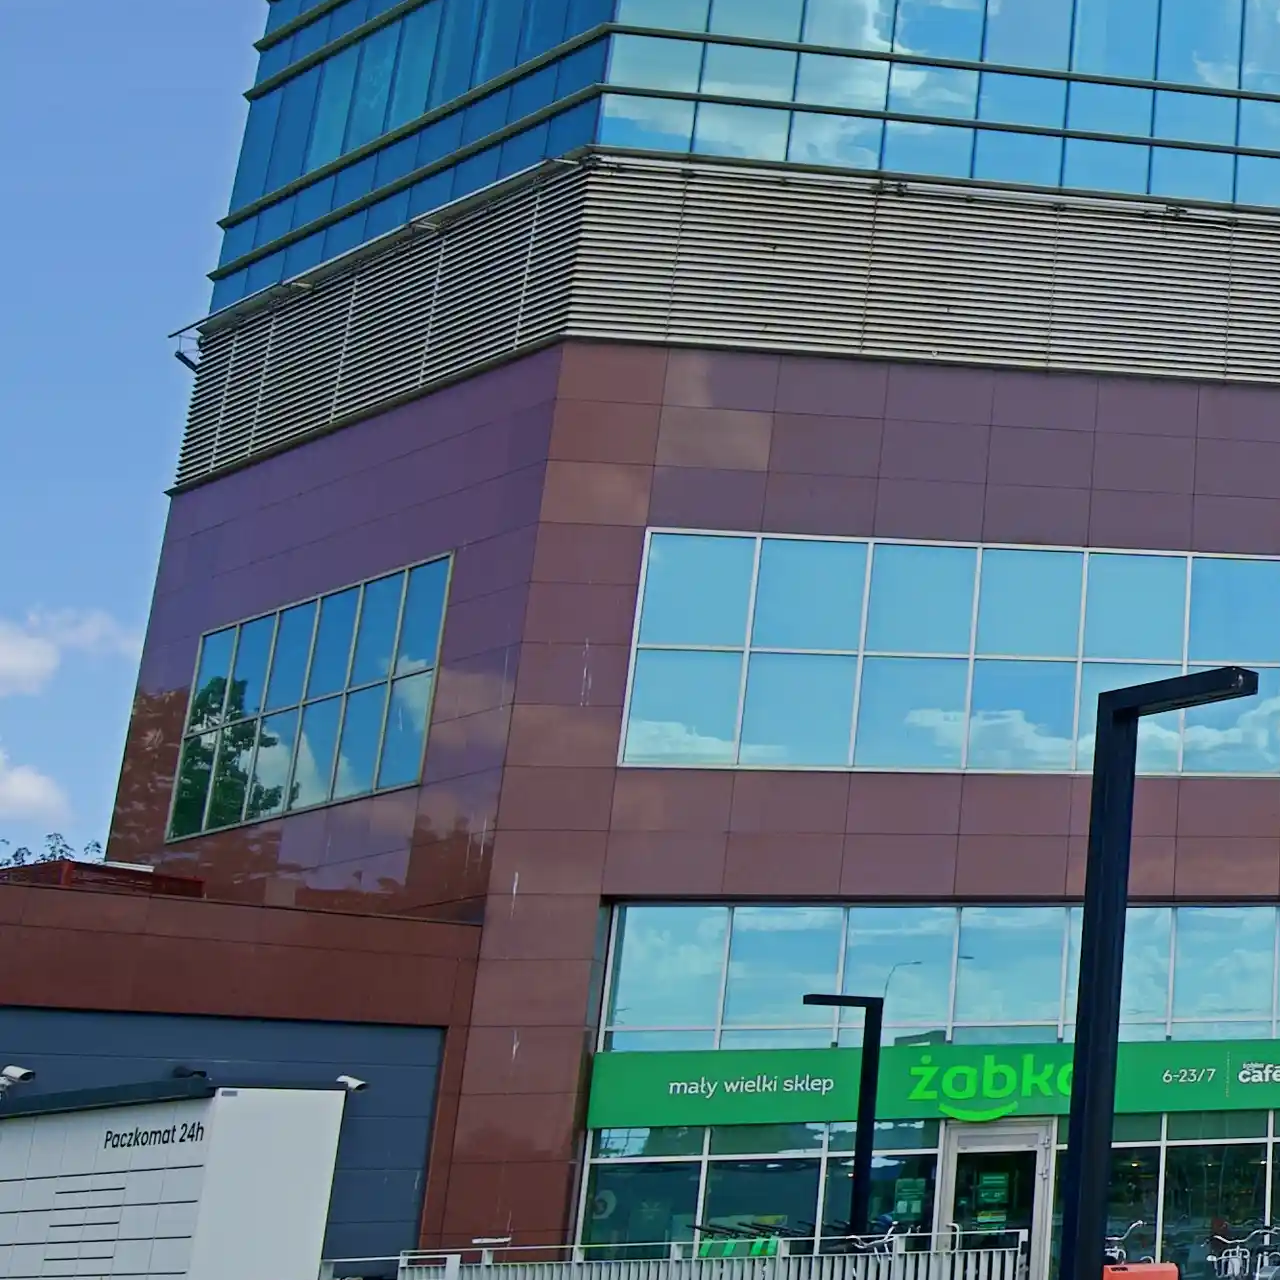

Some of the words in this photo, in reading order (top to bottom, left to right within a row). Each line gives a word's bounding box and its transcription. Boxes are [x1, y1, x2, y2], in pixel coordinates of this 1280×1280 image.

[668, 1075, 718, 1099] mały
[723, 1075, 778, 1093] wielki
[783, 1074, 834, 1096] sklep
[1162, 1068, 1217, 1083] 6-23/7
[104, 1125, 177, 1149] Paczkomat
[179, 1121, 205, 1143] 24h
